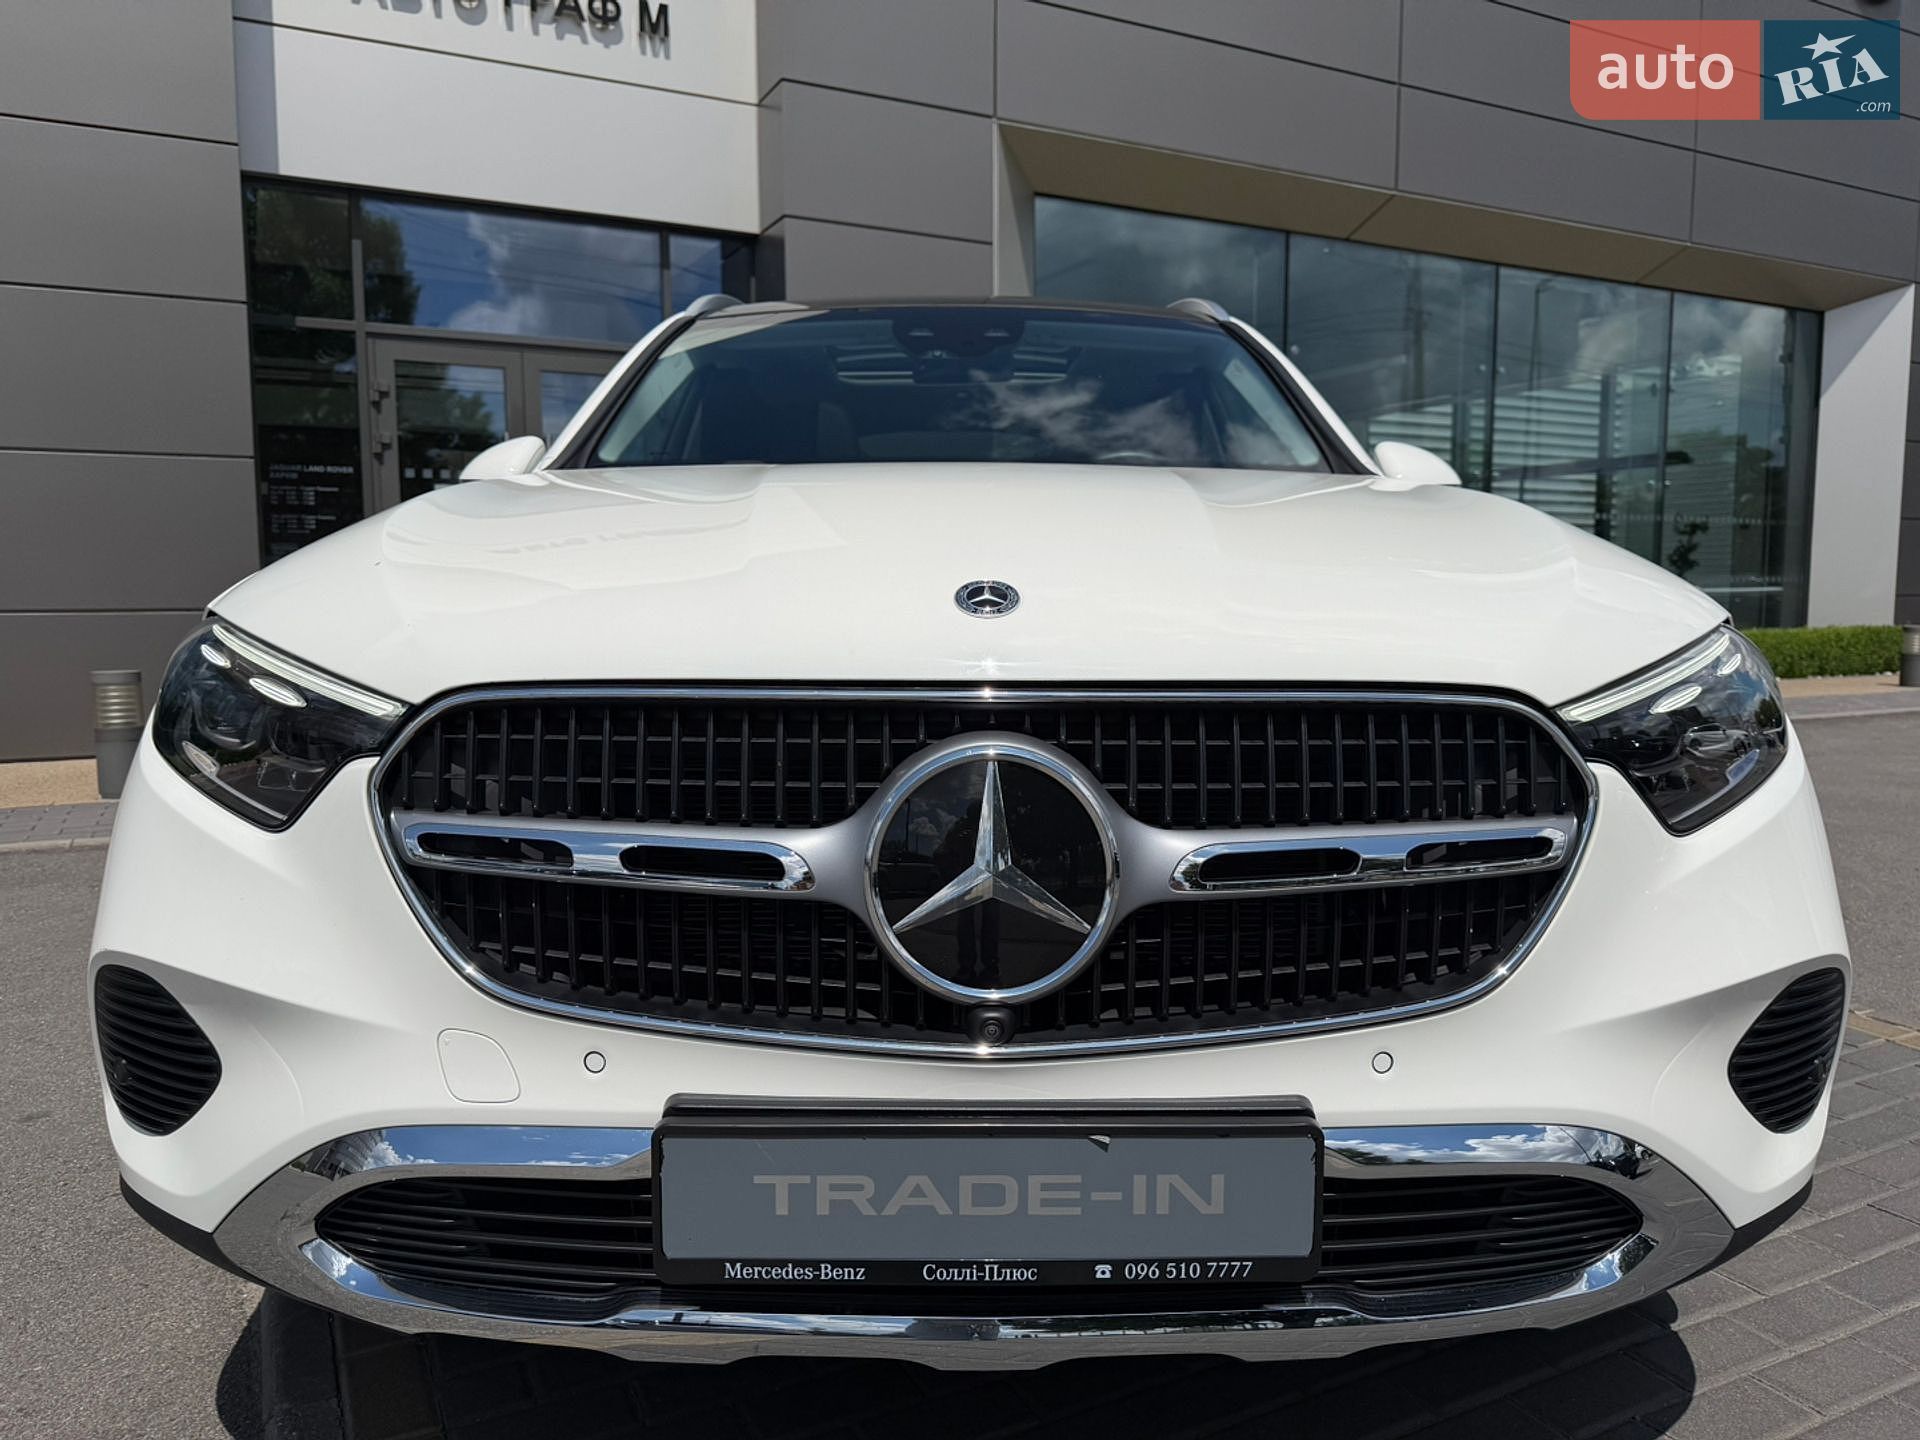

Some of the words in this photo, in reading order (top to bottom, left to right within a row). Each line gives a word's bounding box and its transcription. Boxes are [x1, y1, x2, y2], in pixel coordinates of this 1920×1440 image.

[303, 464, 325, 473] LAND
[326, 465, 354, 474] ROVER
[753, 1174, 1226, 1216] TRADE-IN
[724, 1262, 866, 1280] Mercedes-Benz
[922, 1263, 1038, 1281] Соллі-Плюс
[1124, 1262, 1160, 1280] 096
[1165, 1262, 1201, 1279] 510
[1206, 1261, 1254, 1279] 7777
